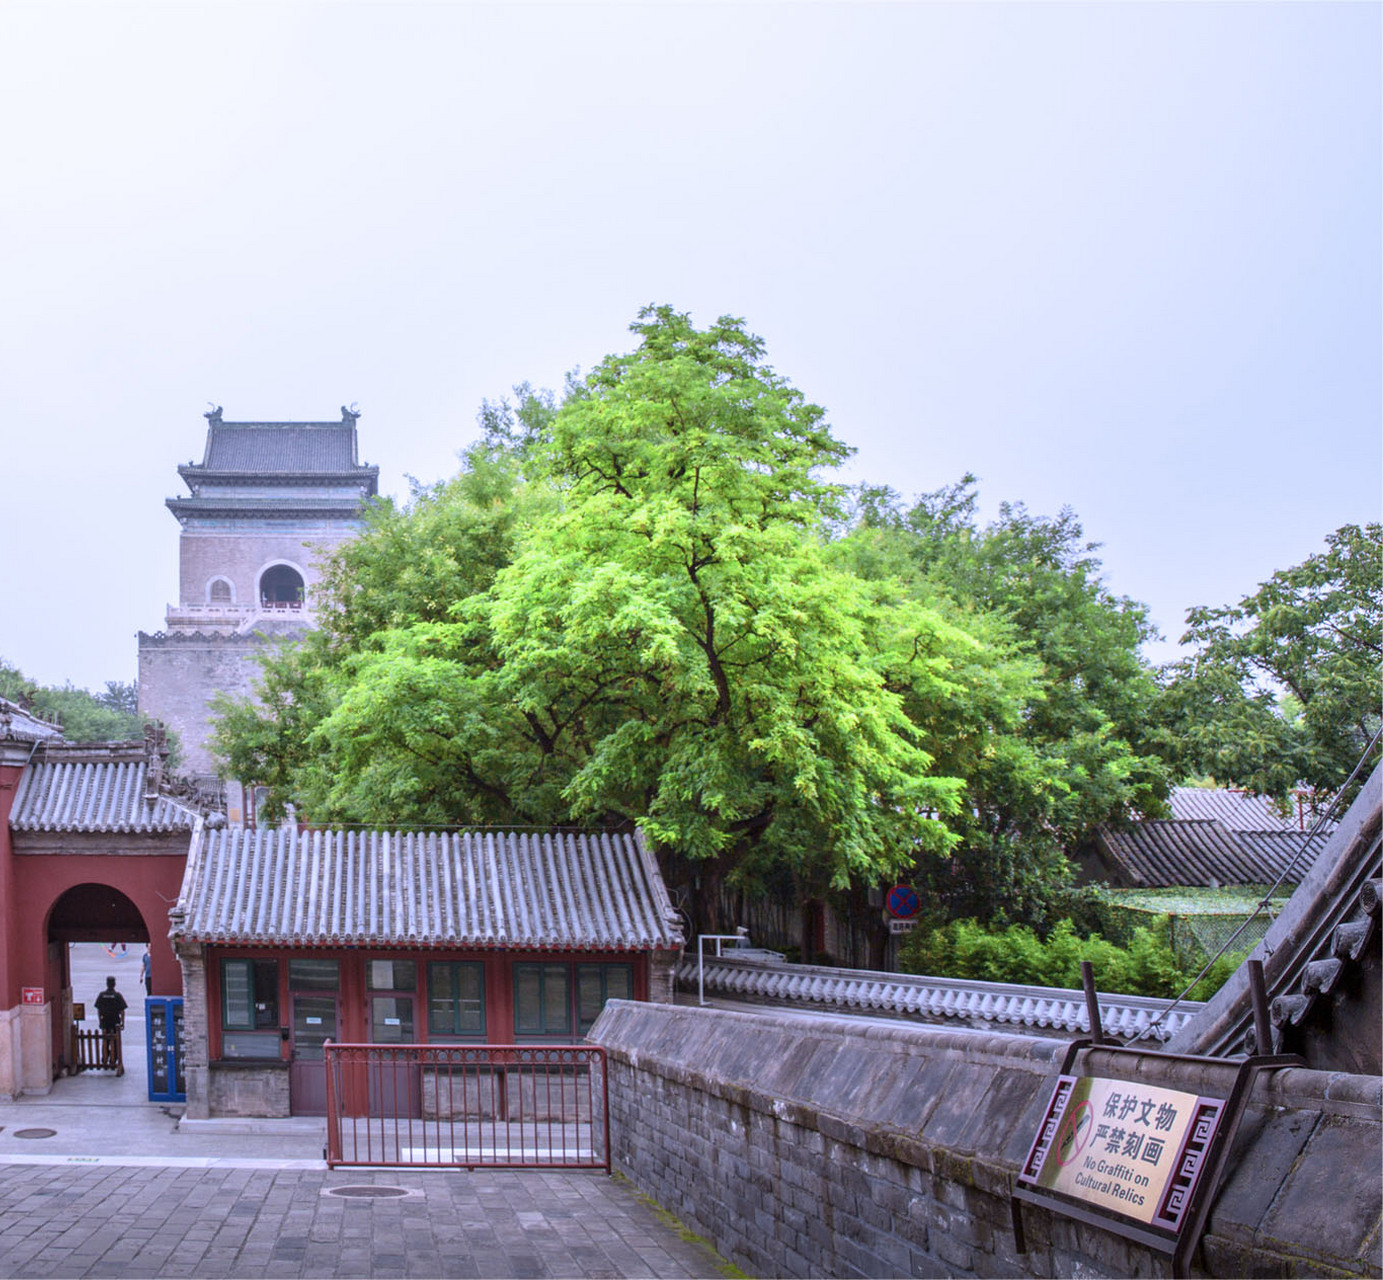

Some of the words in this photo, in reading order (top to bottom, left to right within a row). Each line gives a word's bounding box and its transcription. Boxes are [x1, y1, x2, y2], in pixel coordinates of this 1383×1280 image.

[1102, 1092, 1178, 1132] 保护文物
[1089, 1124, 1165, 1167] 严禁刻画
[1075, 1172, 1111, 1194] Cultural
[1111, 1185, 1145, 1206] Relics
[1083, 1156, 1096, 1170] No
[1097, 1159, 1135, 1182] Graffiti
[1135, 1174, 1150, 1188] on
